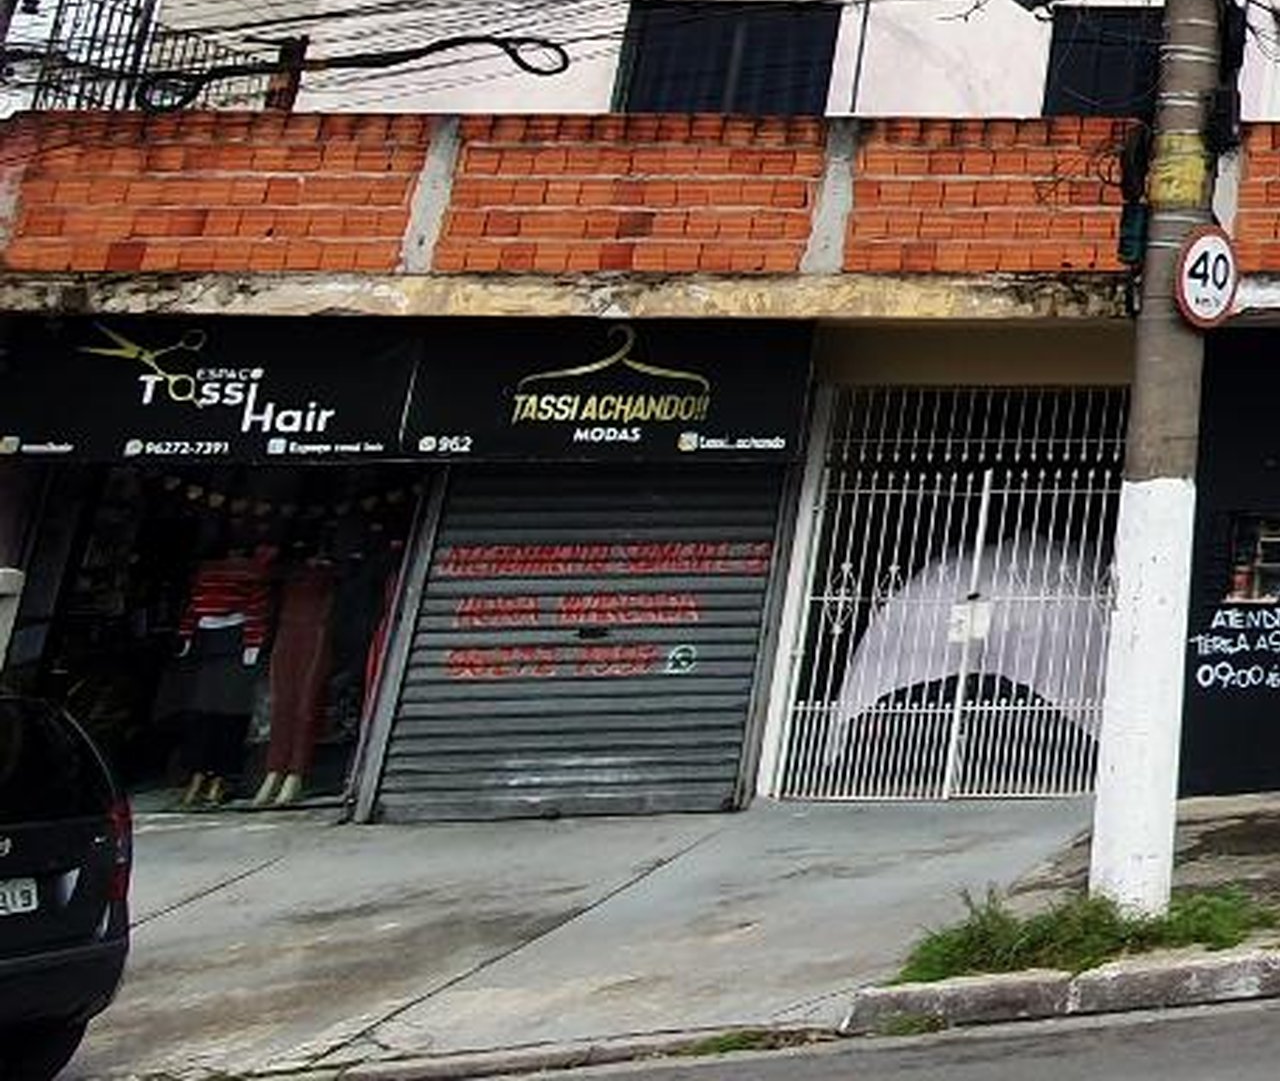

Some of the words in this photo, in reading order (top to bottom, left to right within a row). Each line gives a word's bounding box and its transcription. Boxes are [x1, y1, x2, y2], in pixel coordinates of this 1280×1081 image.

[1188, 250, 1230, 290] 40
[241, 401, 335, 432] Hair
[512, 394, 580, 423] TASSI
[437, 436, 472, 451] 962
[573, 427, 642, 441] MODAS
